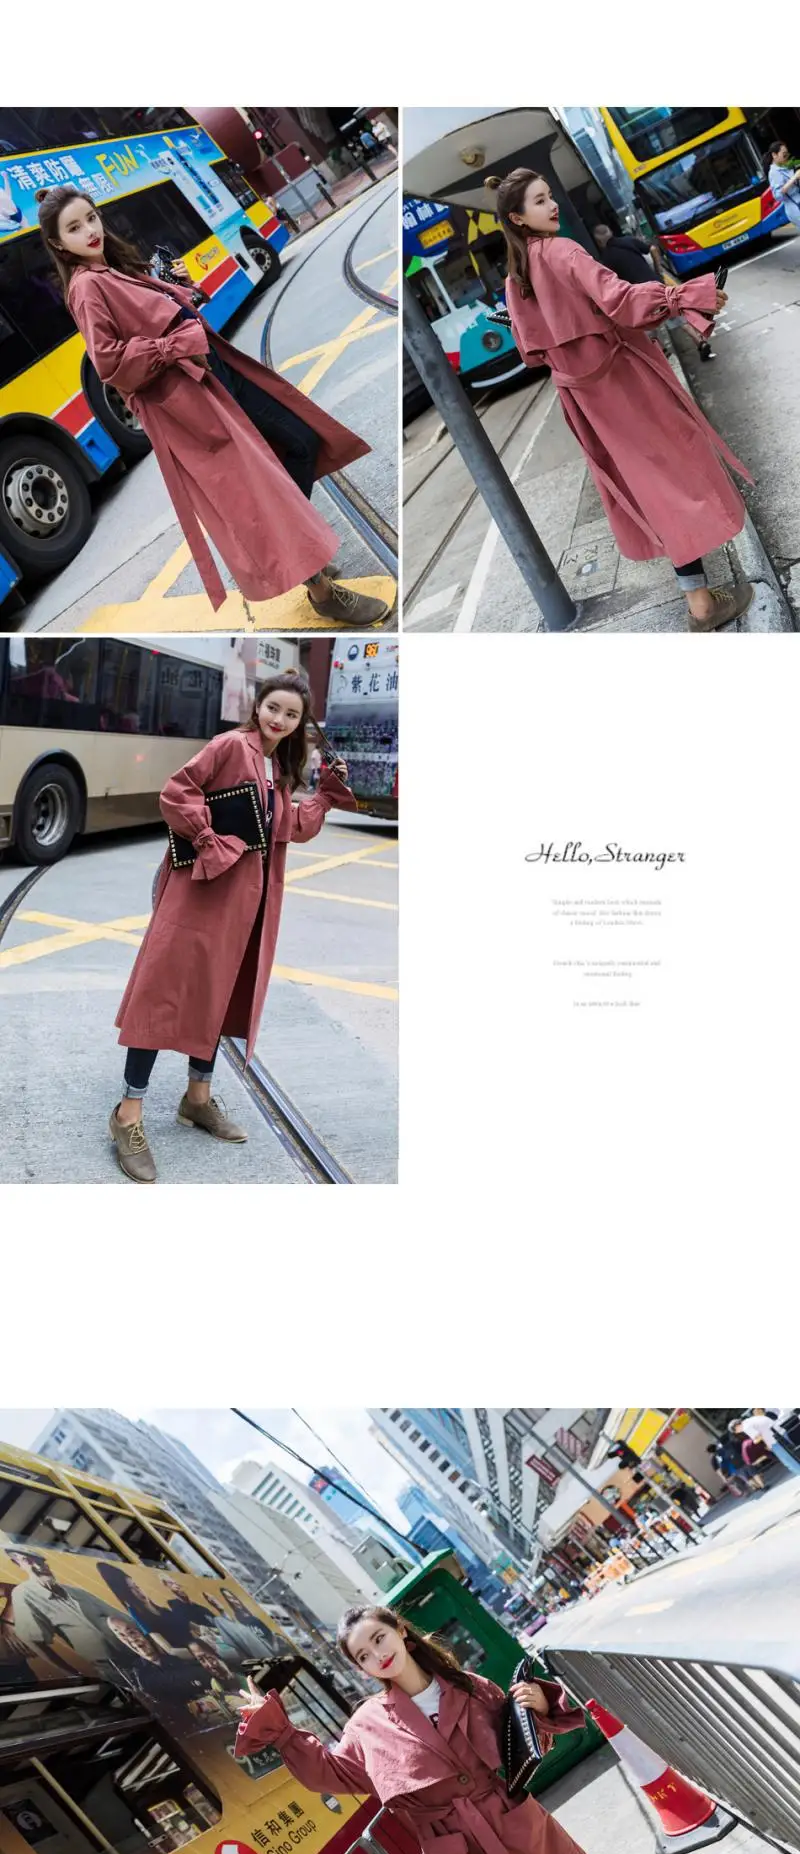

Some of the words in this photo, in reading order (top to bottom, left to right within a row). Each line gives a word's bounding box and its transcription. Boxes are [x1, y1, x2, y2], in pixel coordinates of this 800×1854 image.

[95, 144, 140, 187] FUN
[251, 1801, 305, 1848] 信和集團
[288, 1818, 317, 1844] Group
